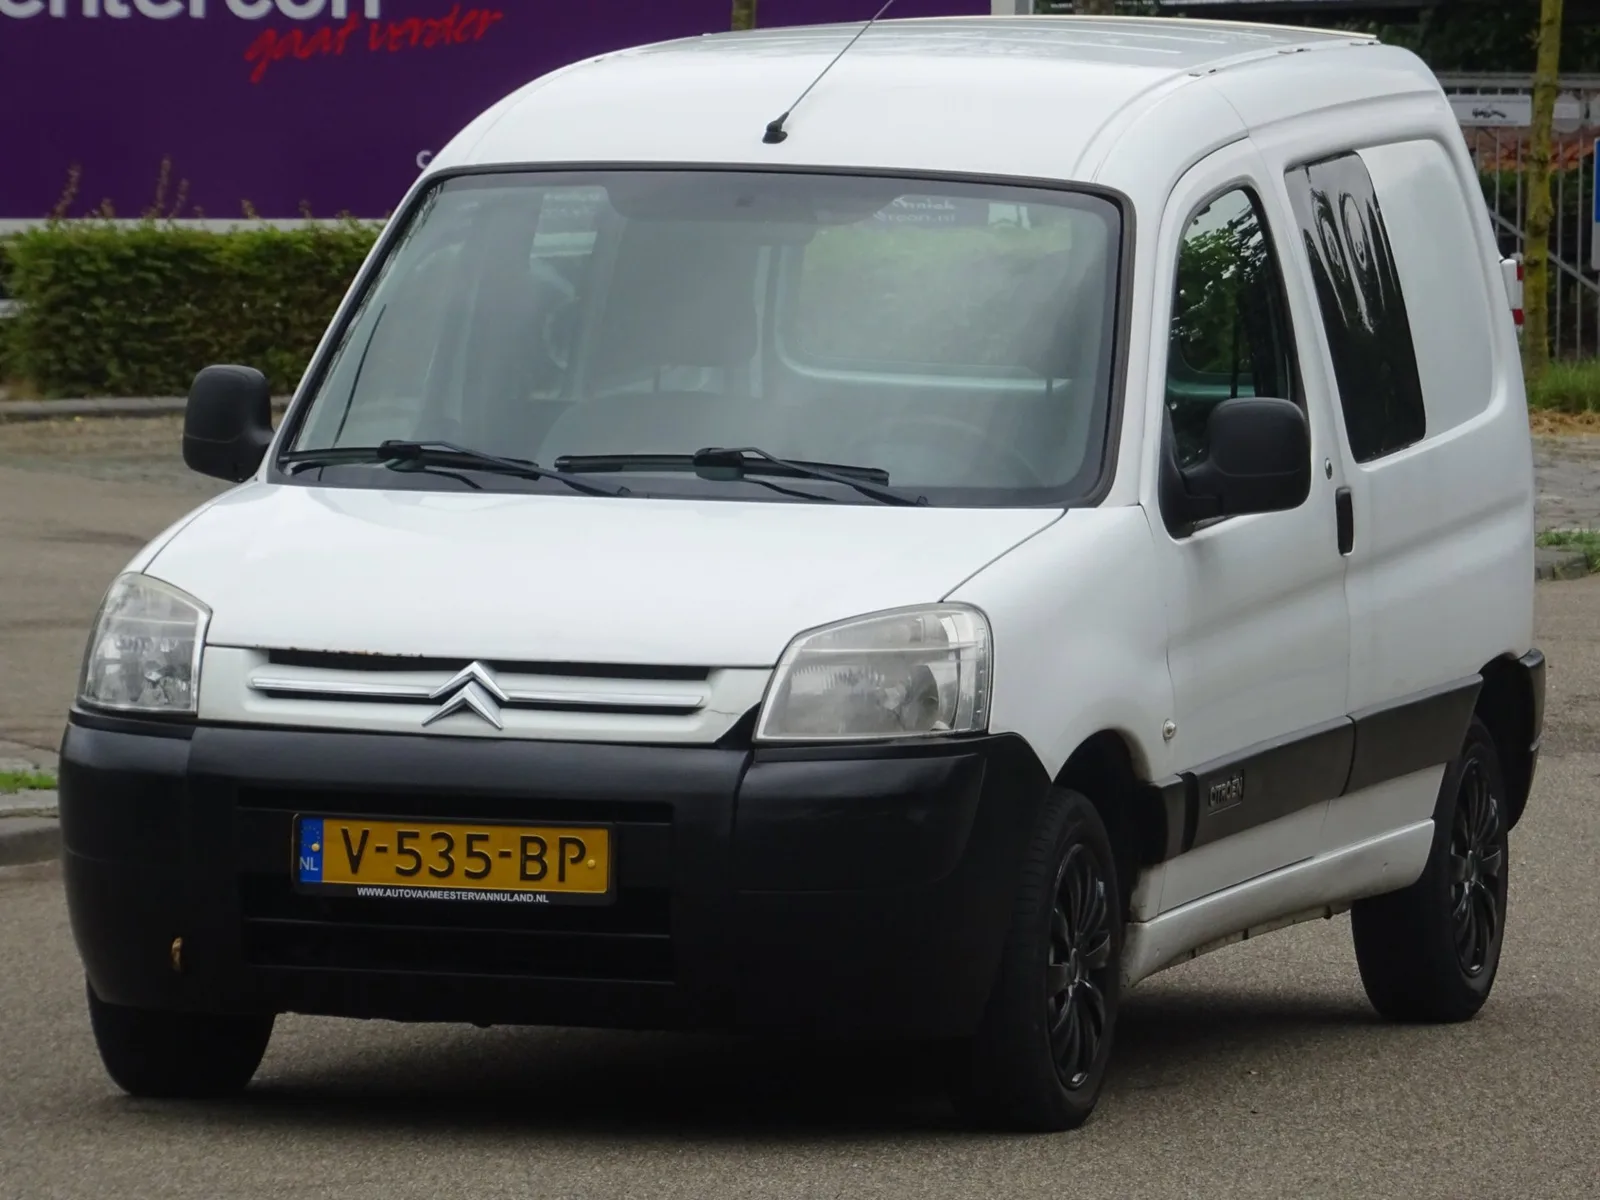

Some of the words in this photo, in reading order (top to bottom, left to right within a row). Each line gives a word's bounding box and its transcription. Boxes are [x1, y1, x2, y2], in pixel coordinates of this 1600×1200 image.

[340, 826, 587, 883] V-535-BP
[299, 856, 319, 872] NL
[356, 886, 549, 904] WWW.AUTOVAKMEESTERVANNULAND.NL
